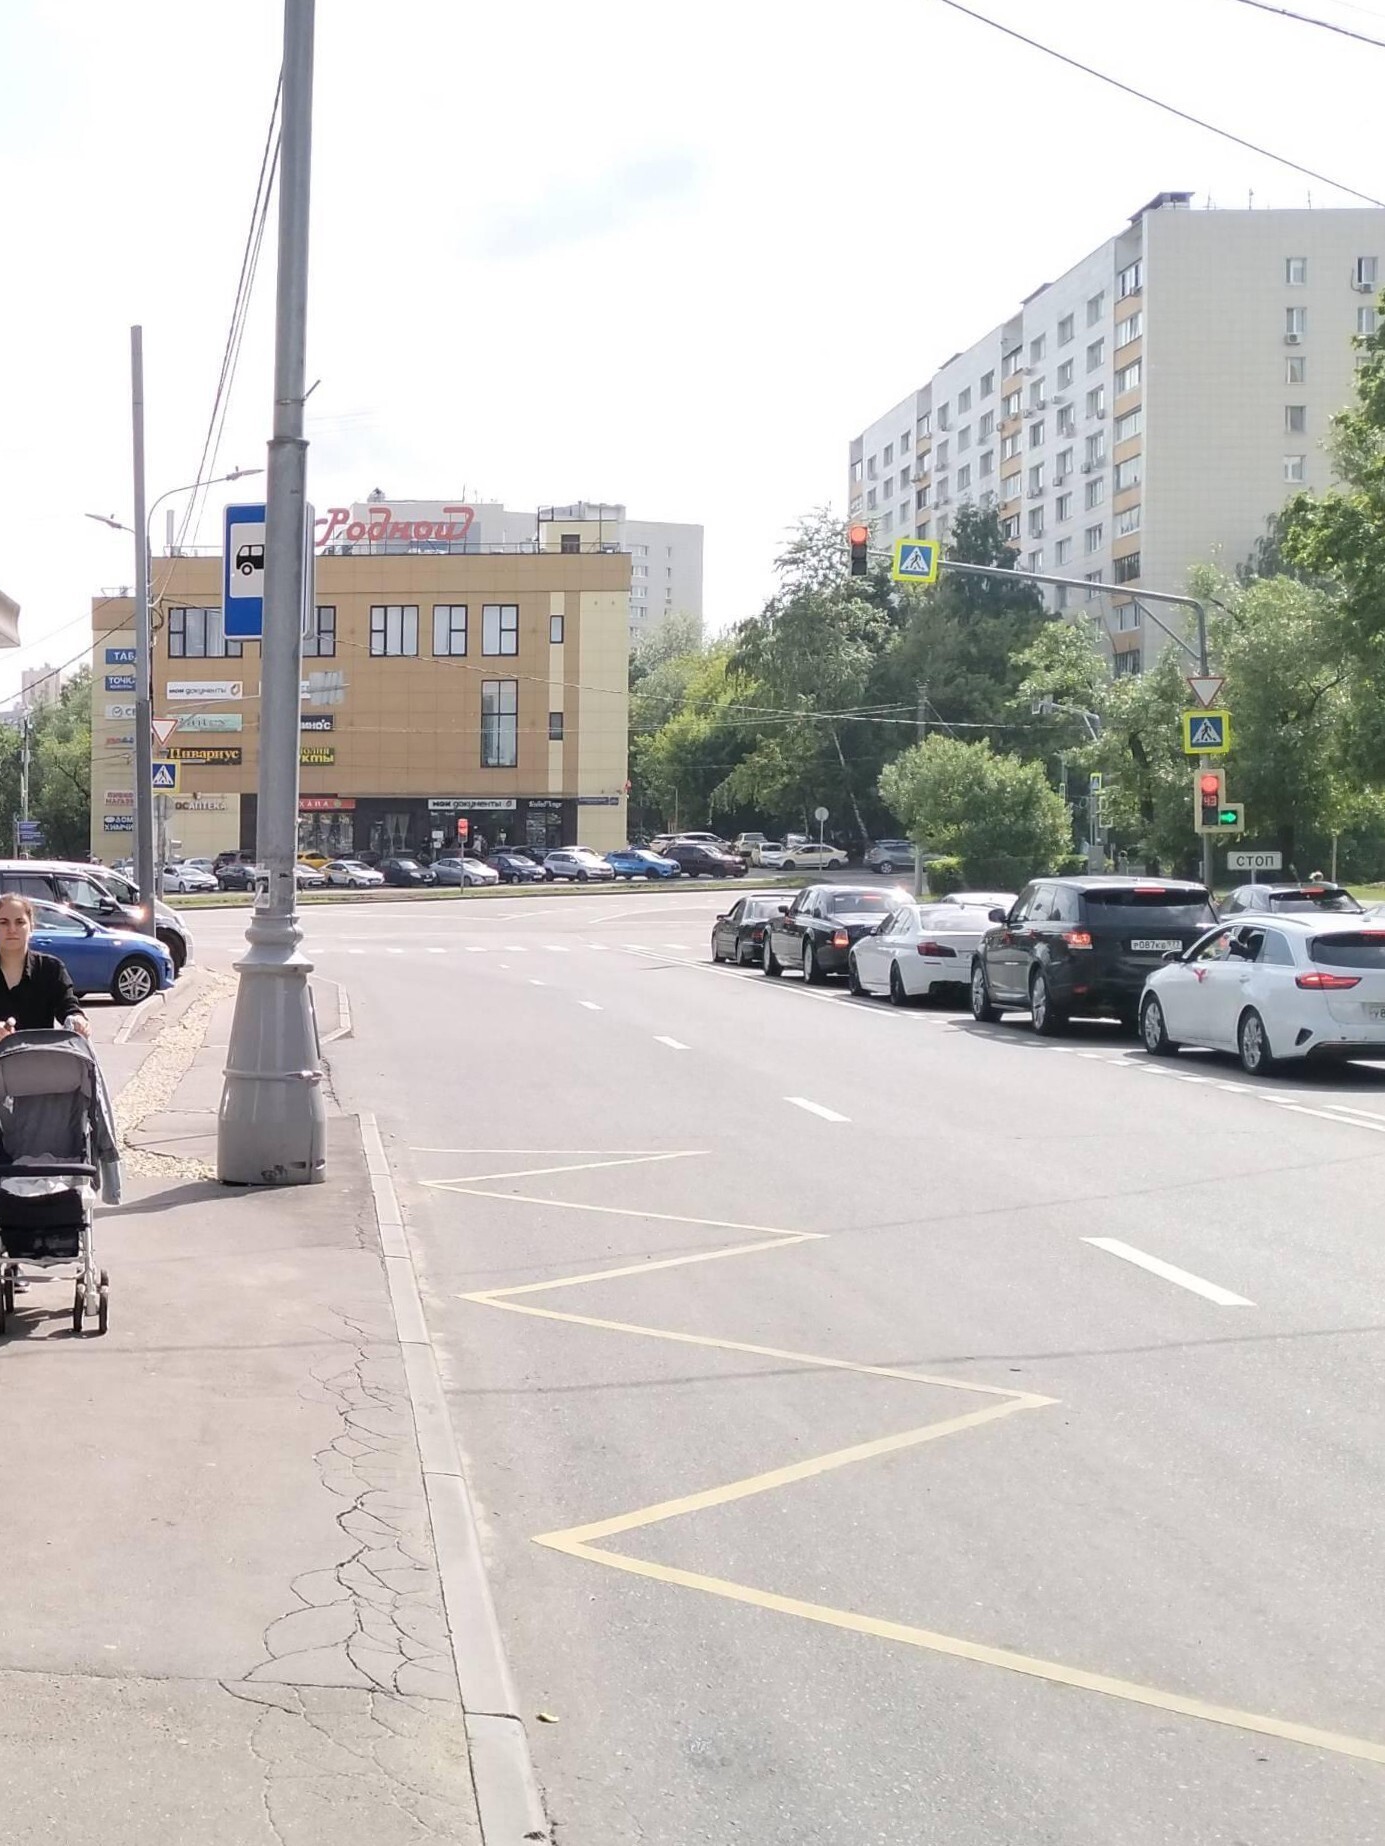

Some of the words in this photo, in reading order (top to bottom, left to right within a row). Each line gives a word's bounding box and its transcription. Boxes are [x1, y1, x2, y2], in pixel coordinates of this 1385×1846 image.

[315, 507, 474, 546] Родной
[114, 652, 137, 661] ТАБ
[169, 748, 239, 761] Пивариус
[175, 801, 227, 811] ОСАПТЕКА
[453, 800, 502, 809] документы
[1236, 854, 1275, 866] СТОП
